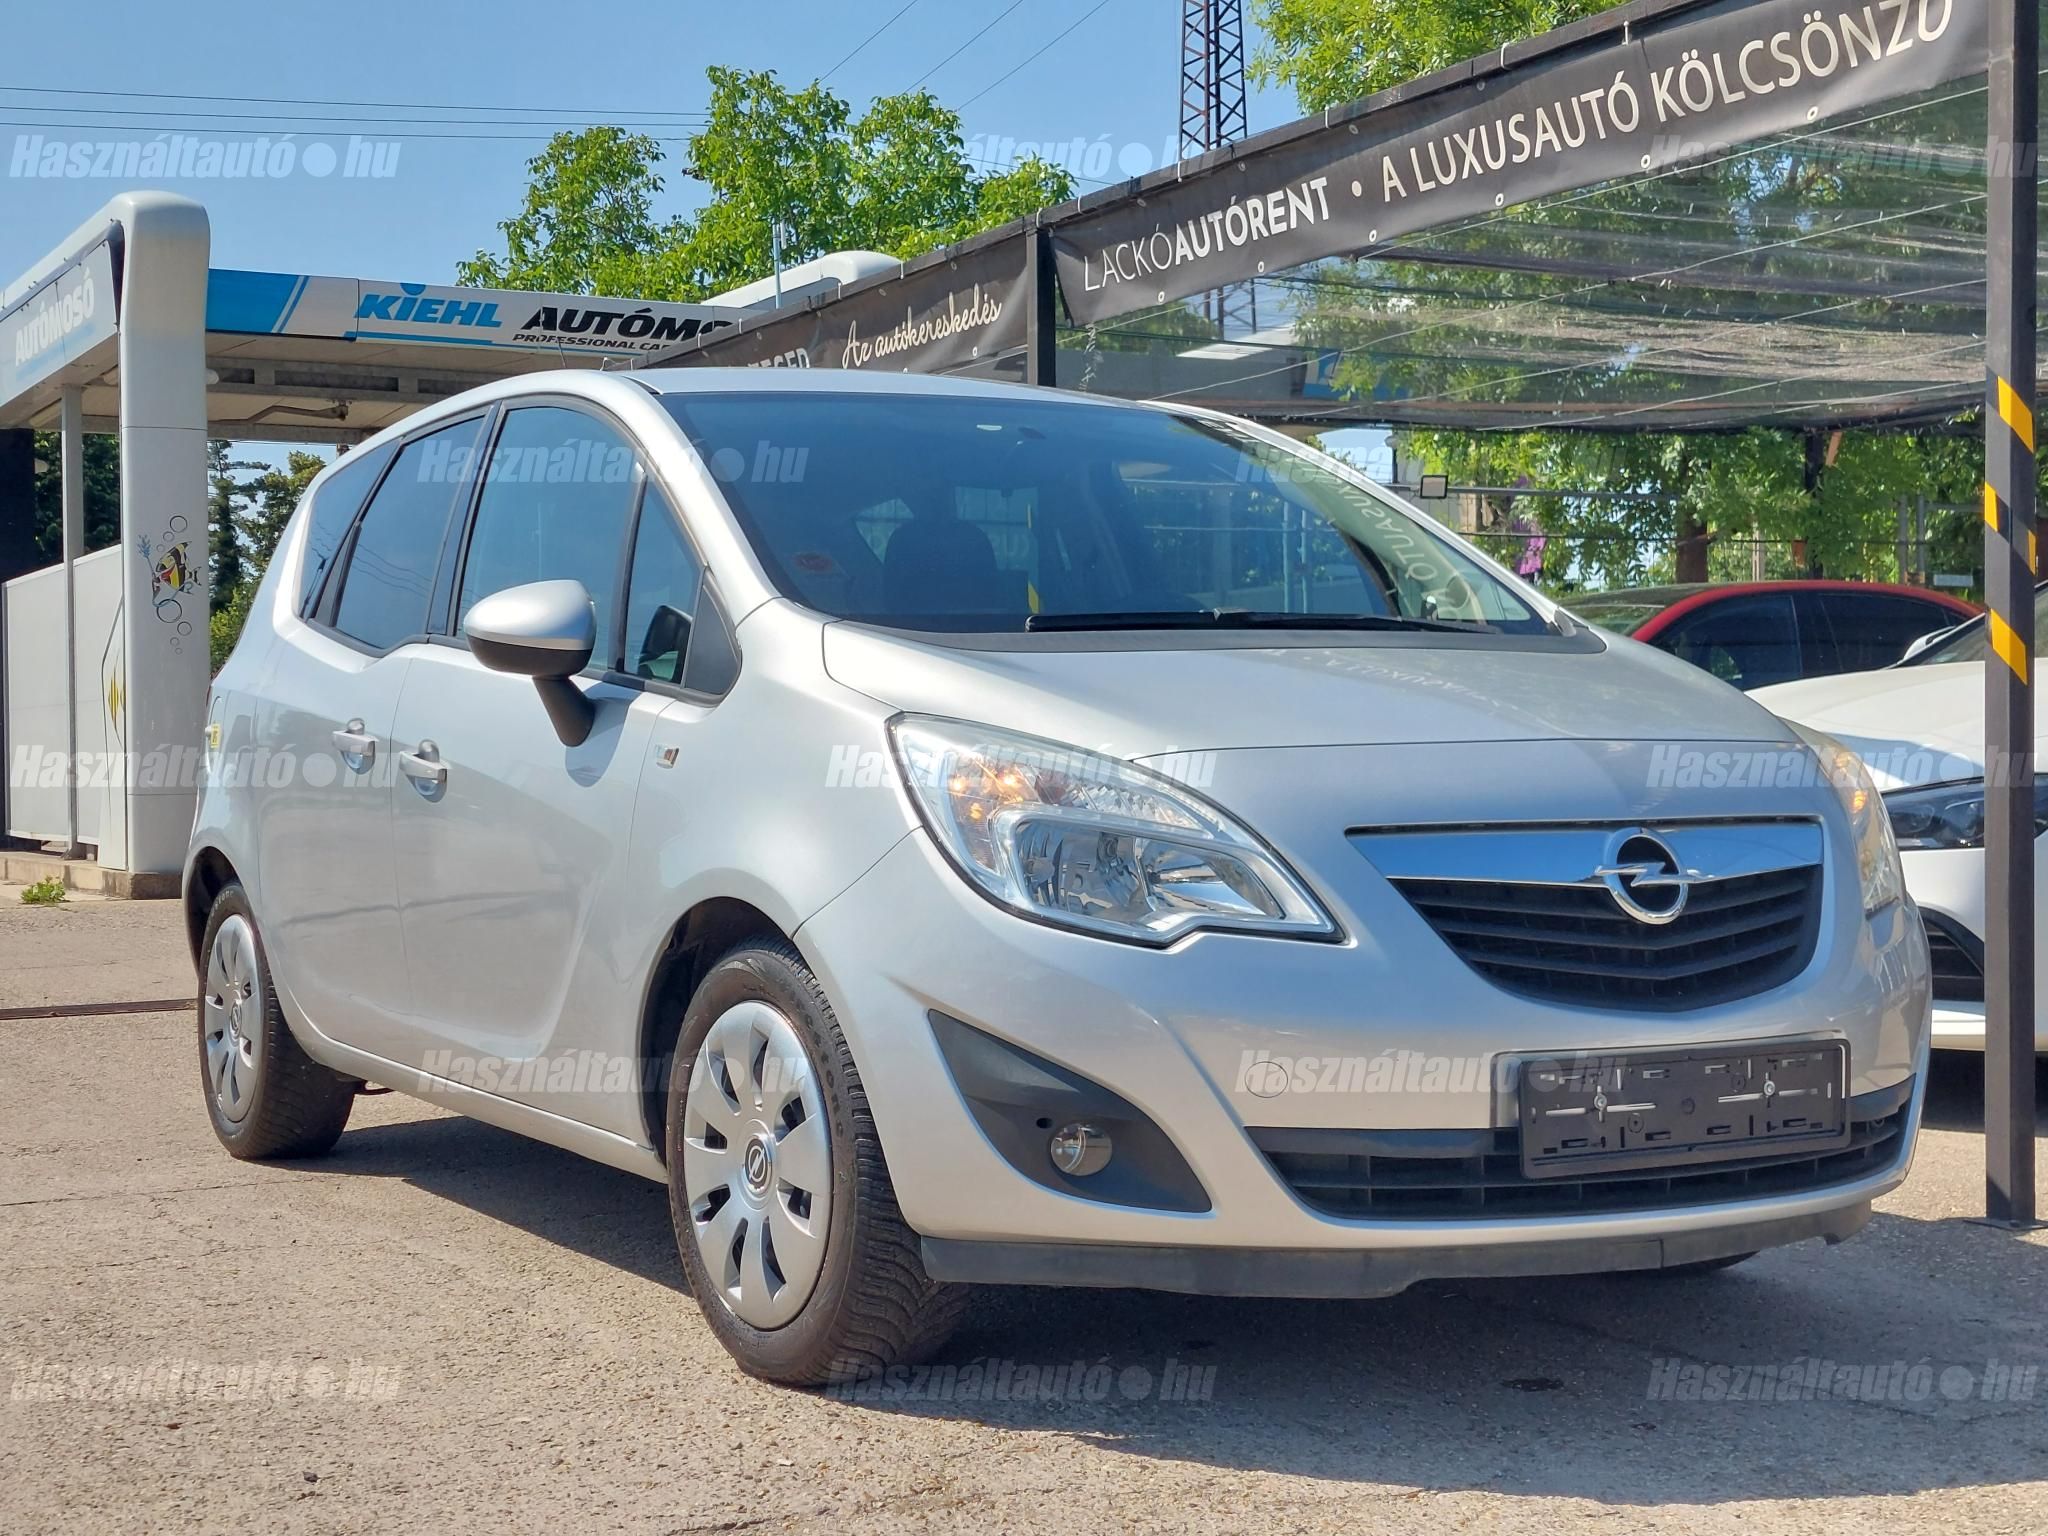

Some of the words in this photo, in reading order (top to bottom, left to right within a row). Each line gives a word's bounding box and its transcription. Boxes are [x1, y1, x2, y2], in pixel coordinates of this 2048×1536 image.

[1083, 176, 1330, 292] LACKÓAUTÓRENT
[1383, 155, 1407, 202] A
[1410, 70, 1640, 193] LUXUSAUTÓ
[15, 267, 95, 367] AUTÓMOSÓ
[512, 333, 636, 350] PROFESSIONAL
